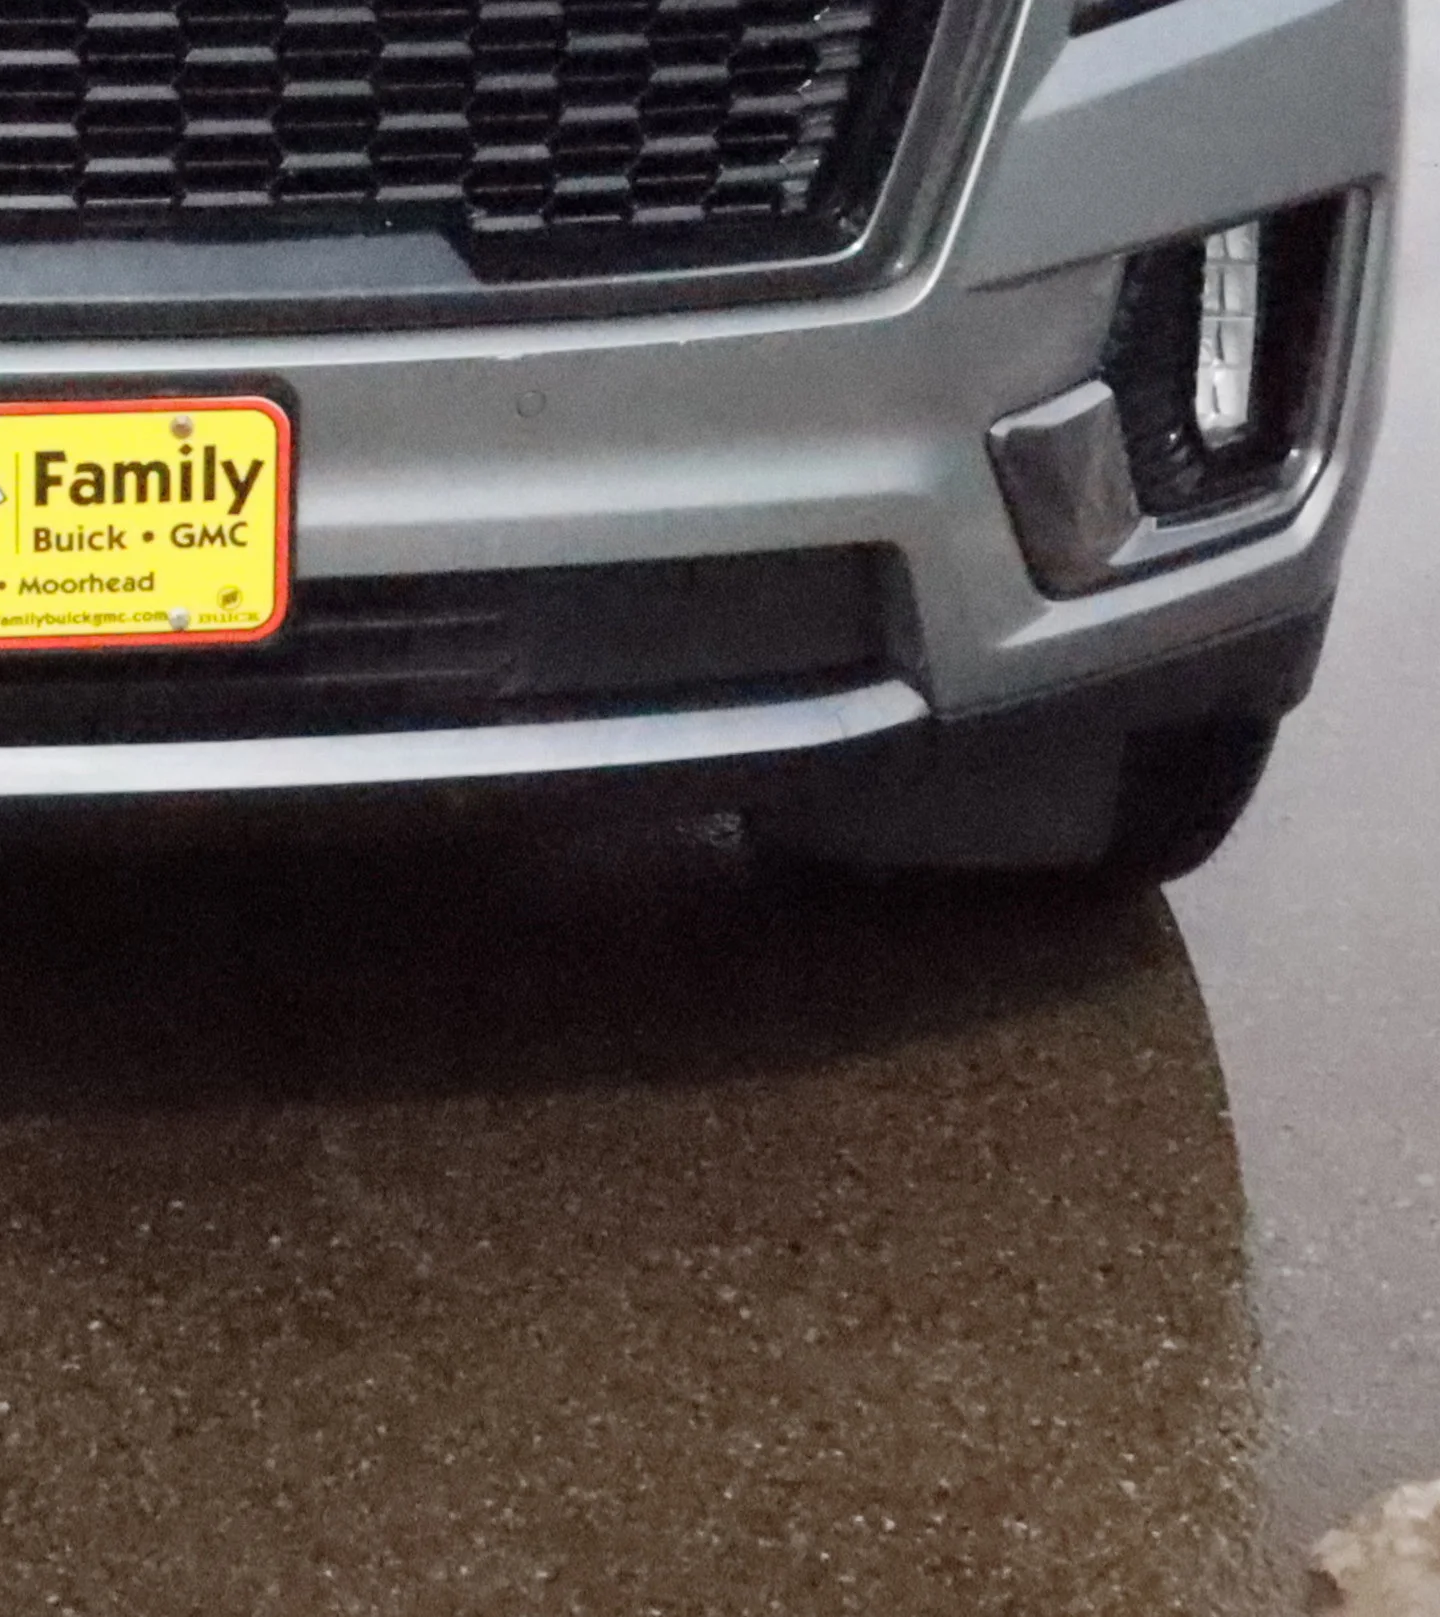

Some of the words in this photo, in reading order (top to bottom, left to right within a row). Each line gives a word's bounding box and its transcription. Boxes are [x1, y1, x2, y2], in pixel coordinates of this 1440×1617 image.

[33, 444, 265, 515] Family
[33, 524, 127, 553] Buick
[170, 521, 249, 548] GMC
[18, 571, 156, 596] Moorhead
